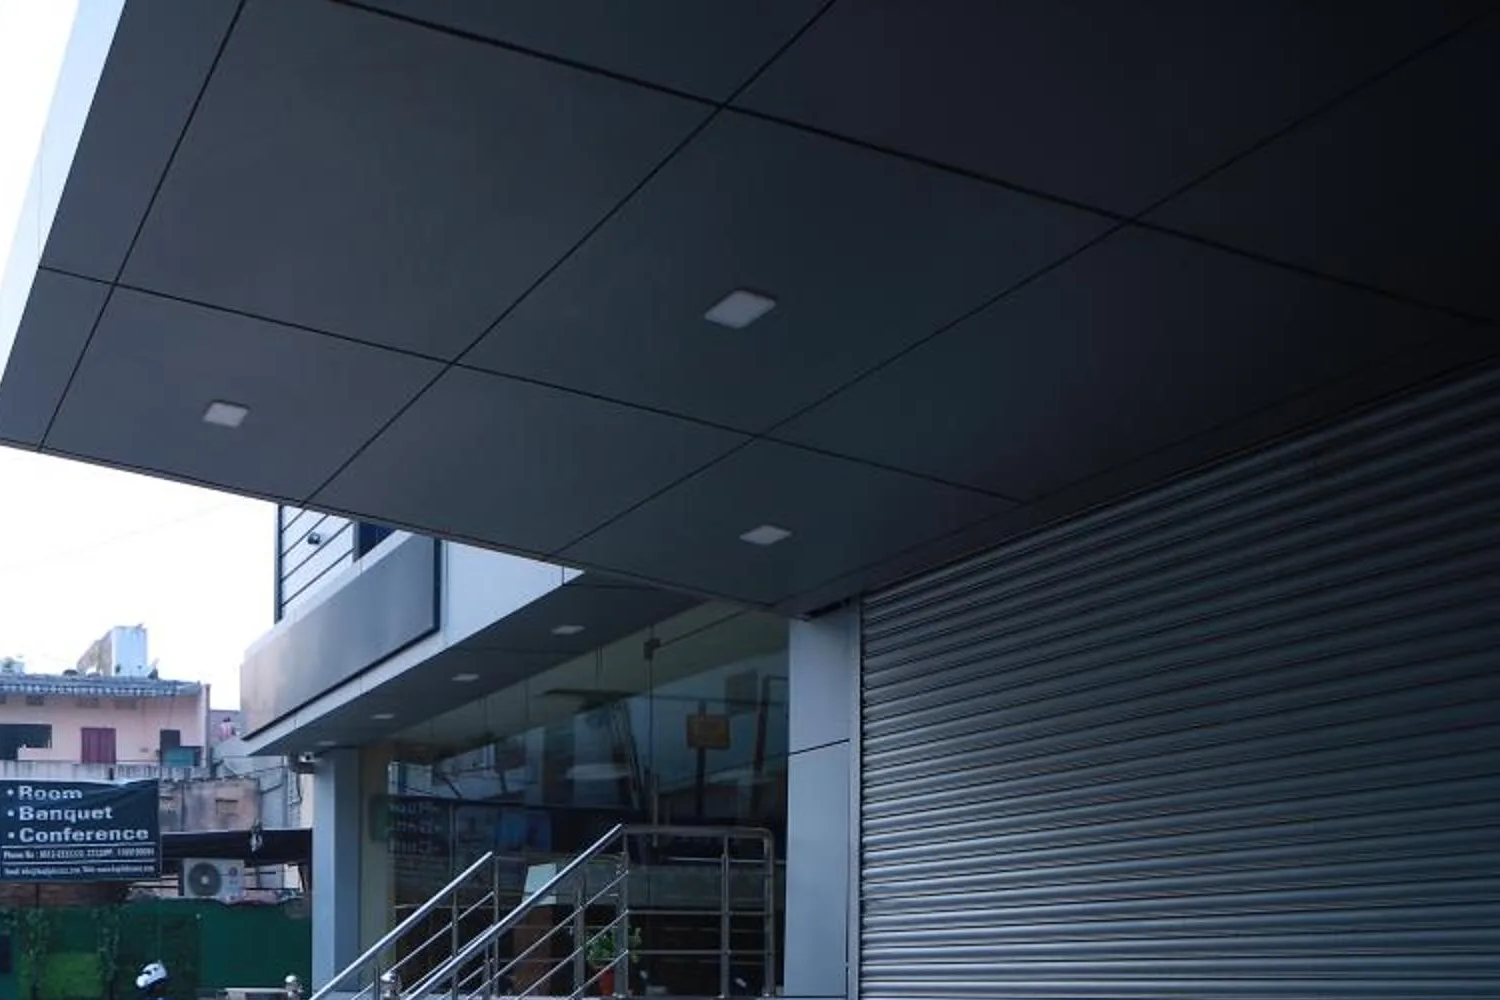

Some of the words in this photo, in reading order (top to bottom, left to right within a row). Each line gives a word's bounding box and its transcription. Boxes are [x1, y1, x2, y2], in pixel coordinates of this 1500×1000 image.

[19, 785, 83, 800] Room
[19, 805, 113, 823] Banquet
[19, 827, 149, 842] Conference
